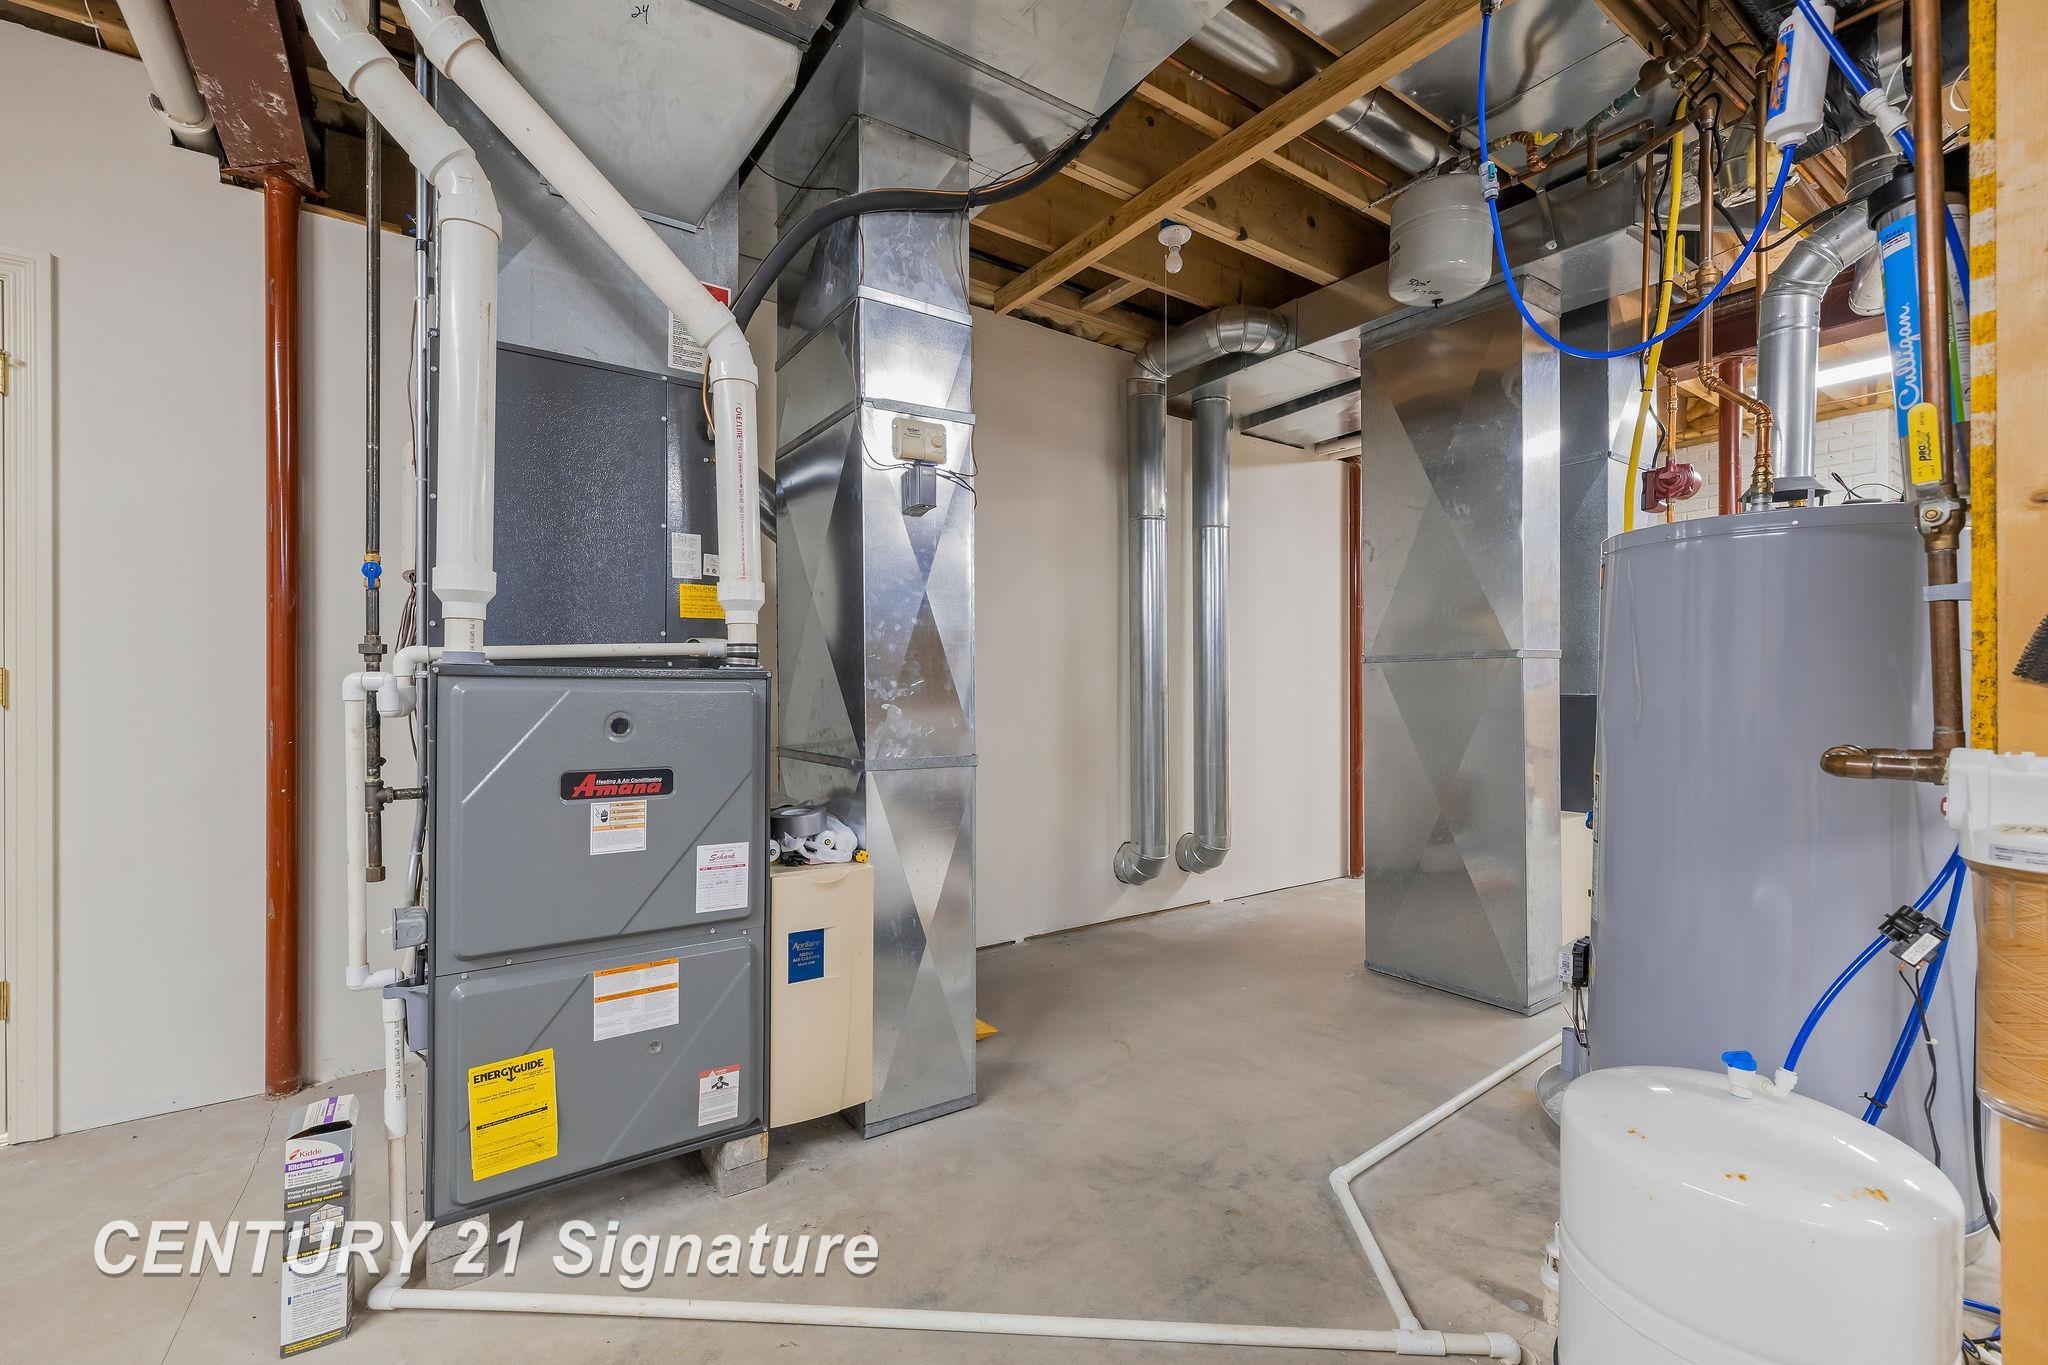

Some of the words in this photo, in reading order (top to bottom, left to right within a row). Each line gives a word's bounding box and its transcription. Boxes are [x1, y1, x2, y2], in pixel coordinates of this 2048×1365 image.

[631, 4, 649, 24] 24
[571, 773, 662, 798] Amana
[630, 776, 663, 784] Conditioning
[299, 1148, 322, 1158] Kidde
[287, 1156, 336, 1172] Kitchen/Garage
[287, 1201, 302, 1209] Where
[312, 1197, 322, 1205] they
